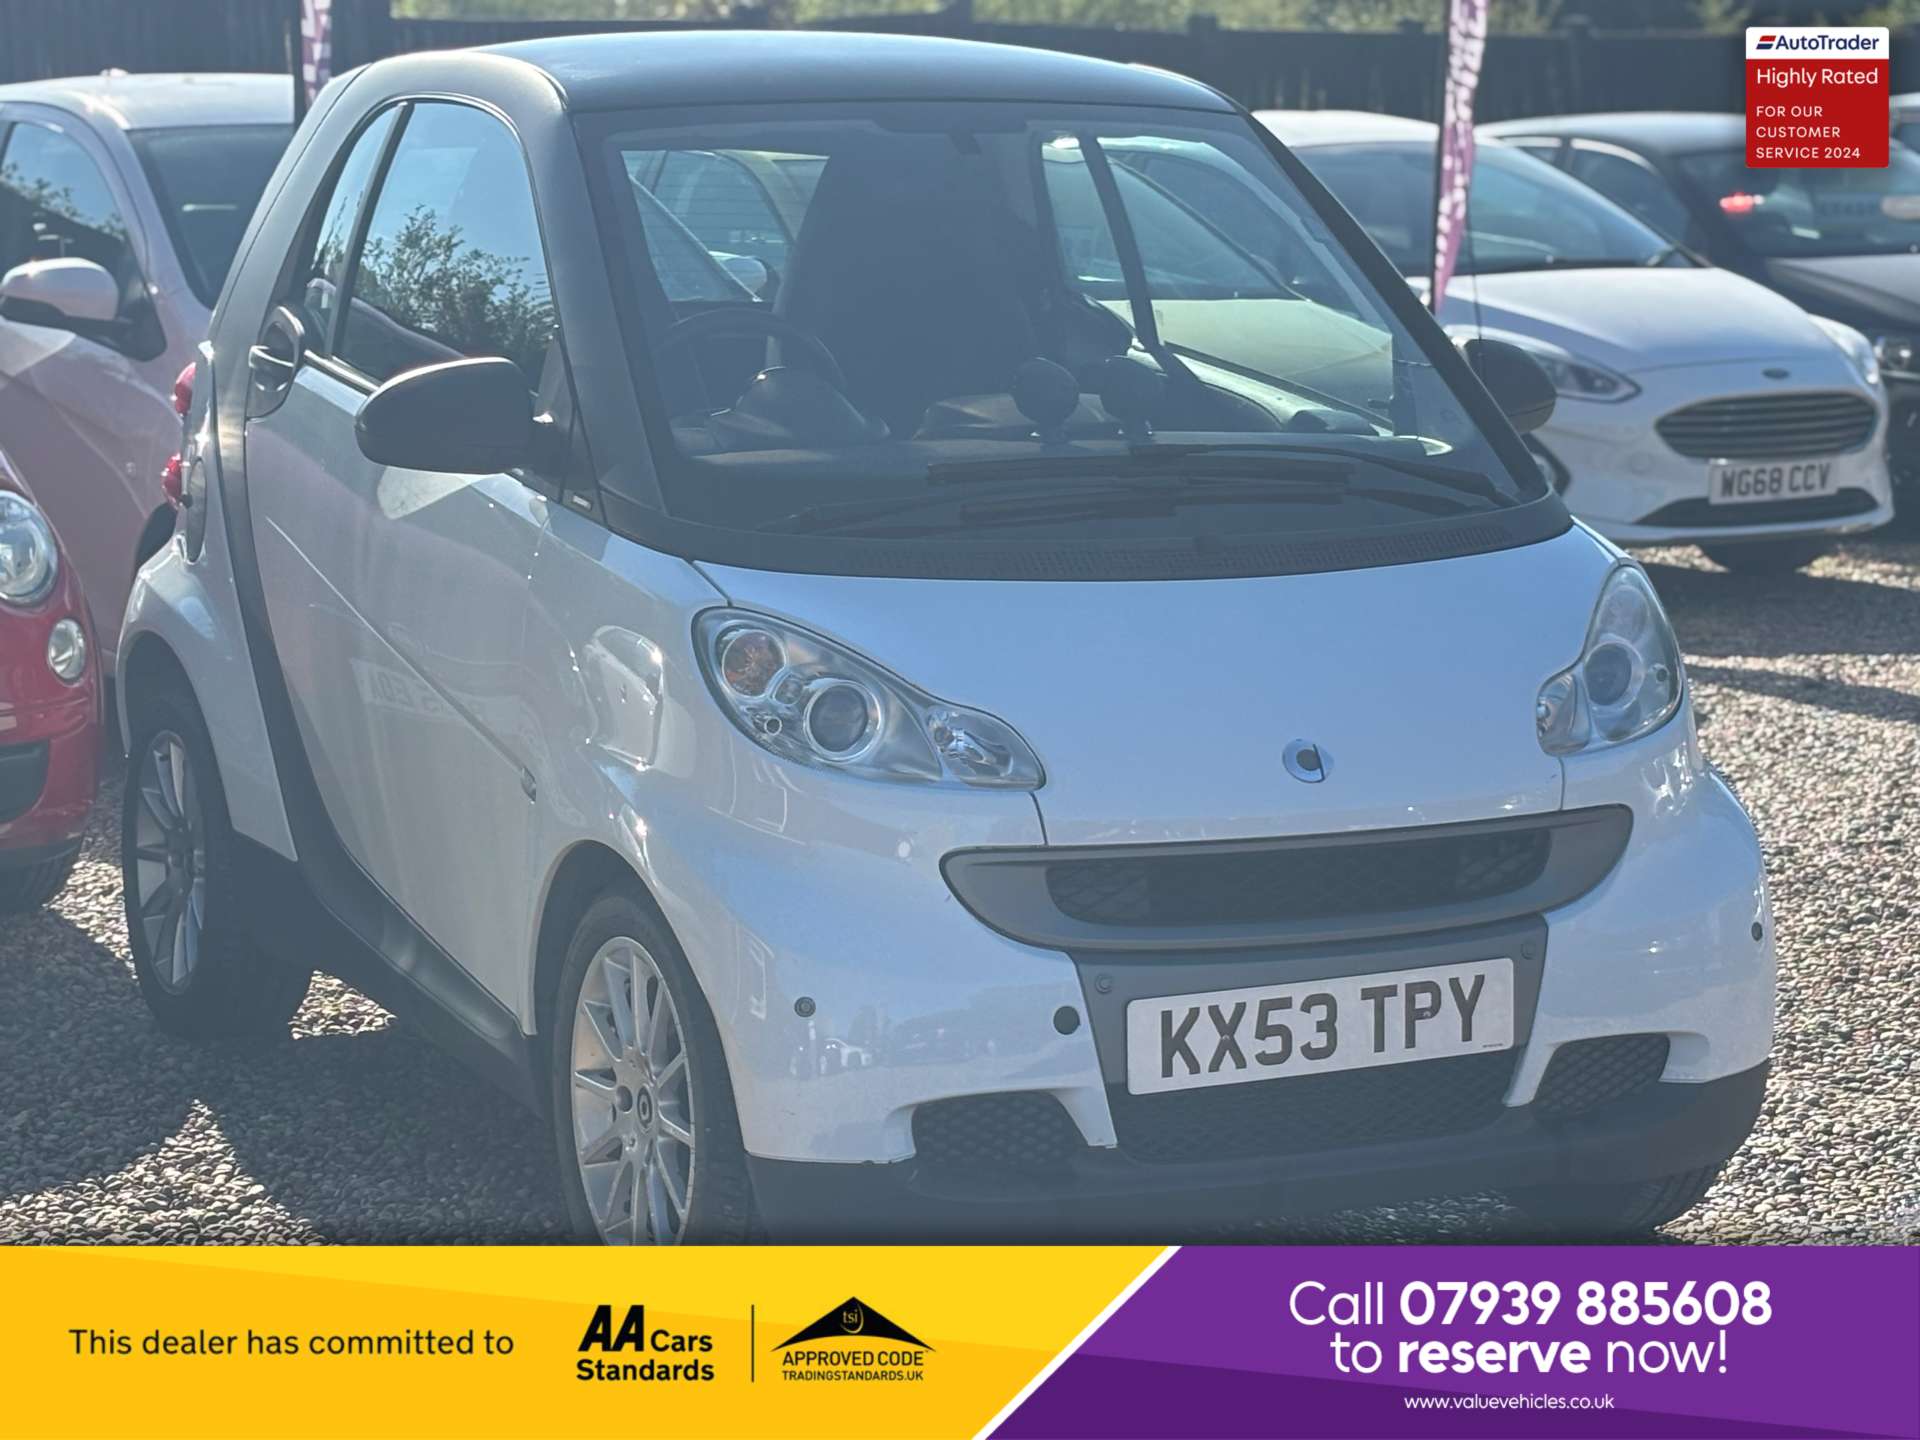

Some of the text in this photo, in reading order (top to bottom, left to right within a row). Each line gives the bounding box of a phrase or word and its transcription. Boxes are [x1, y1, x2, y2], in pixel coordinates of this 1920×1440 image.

[1720, 462, 1831, 498] WG68 CCV
[1160, 973, 1486, 1079] KX53 TPY
